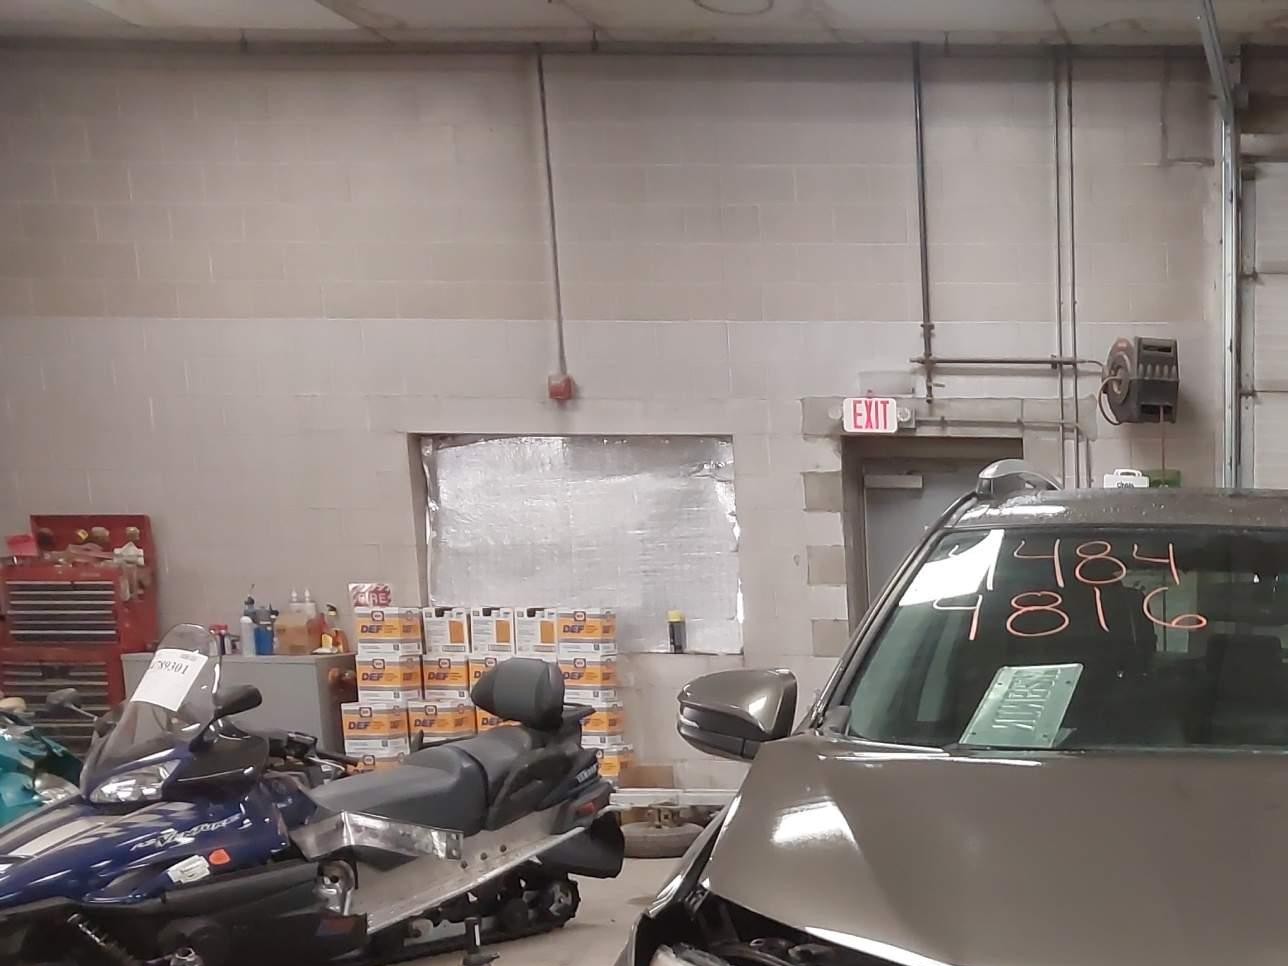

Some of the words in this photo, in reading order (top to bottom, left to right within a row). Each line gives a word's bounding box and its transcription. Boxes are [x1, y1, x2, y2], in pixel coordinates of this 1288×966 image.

[852, 400, 890, 430] EXIT
[361, 624, 383, 633] DEF
[563, 624, 585, 633] DEF
[361, 672, 384, 681] DEF
[427, 671, 448, 680] DEF
[348, 721, 370, 730] DEF
[414, 718, 435, 728] DEF
